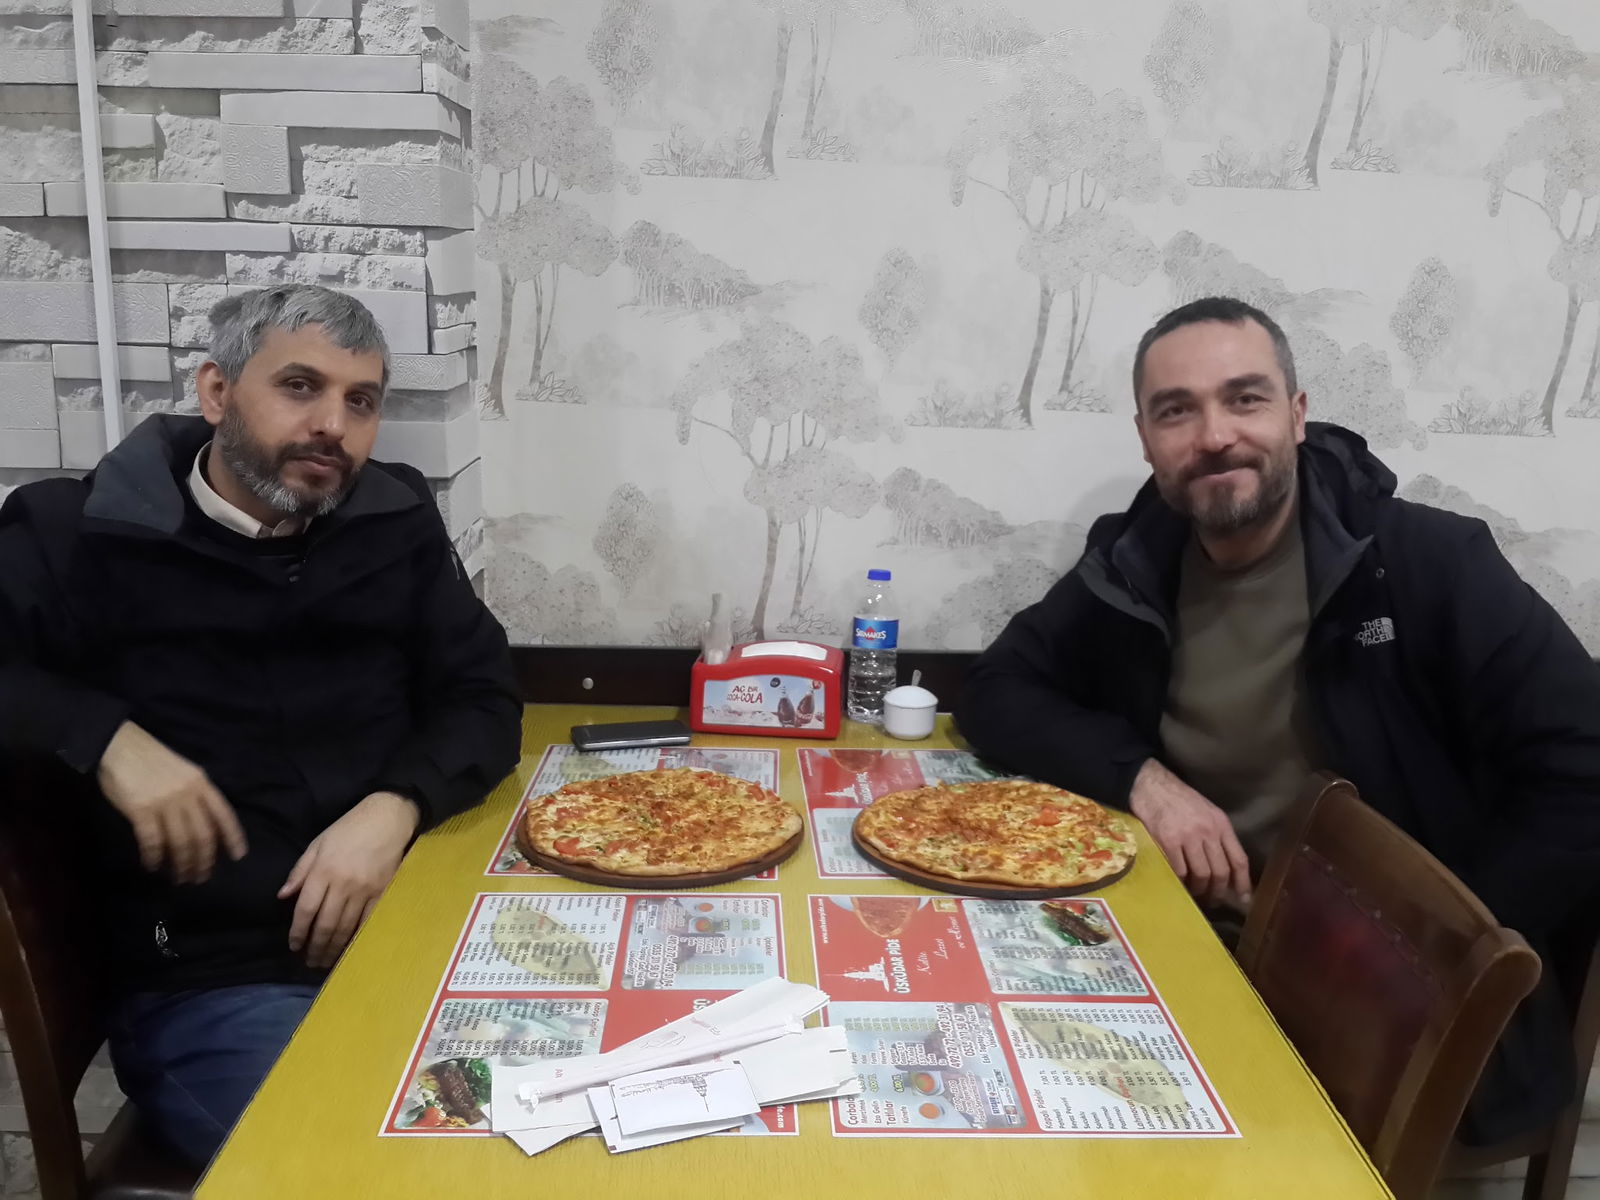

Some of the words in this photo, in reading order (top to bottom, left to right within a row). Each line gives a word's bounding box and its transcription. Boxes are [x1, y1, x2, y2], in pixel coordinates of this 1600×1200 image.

[1361, 618, 1382, 631] THE
[1354, 626, 1384, 641] ORTH
[1362, 634, 1388, 647] FACE
[884, 938, 901, 956] PİDE
[889, 955, 911, 994] ÜSKÜDAR
[939, 1021, 951, 1031] 492
[961, 1041, 974, 1056] 0535
[949, 1055, 961, 1067] 492
[845, 1096, 857, 1125] Çorbala
